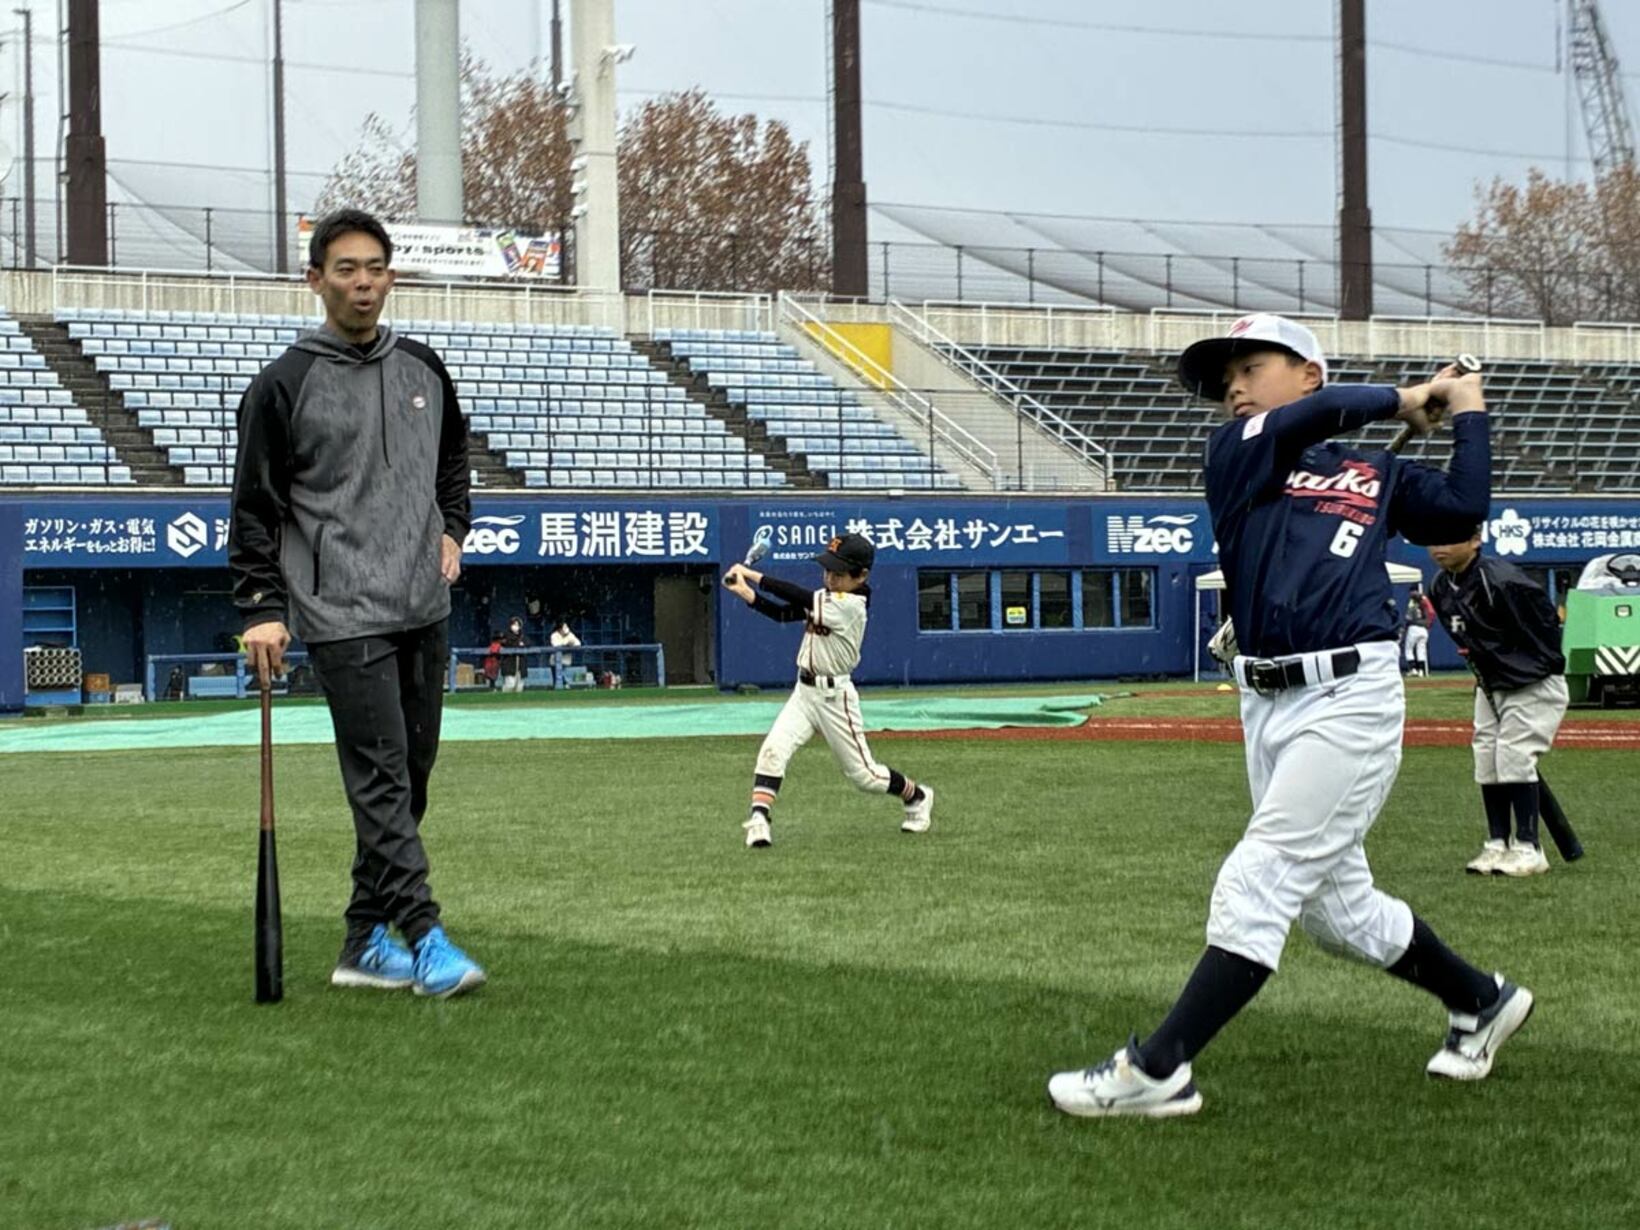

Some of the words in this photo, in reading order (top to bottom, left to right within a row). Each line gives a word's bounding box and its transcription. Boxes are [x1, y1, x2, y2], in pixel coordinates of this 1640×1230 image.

[24, 518, 156, 535] ガソリン・ガス・電気
[538, 511, 709, 557] 馬淵建設
[1329, 520, 1365, 558] 6
[1499, 524, 1524, 538] HKS
[462, 527, 520, 554] zec
